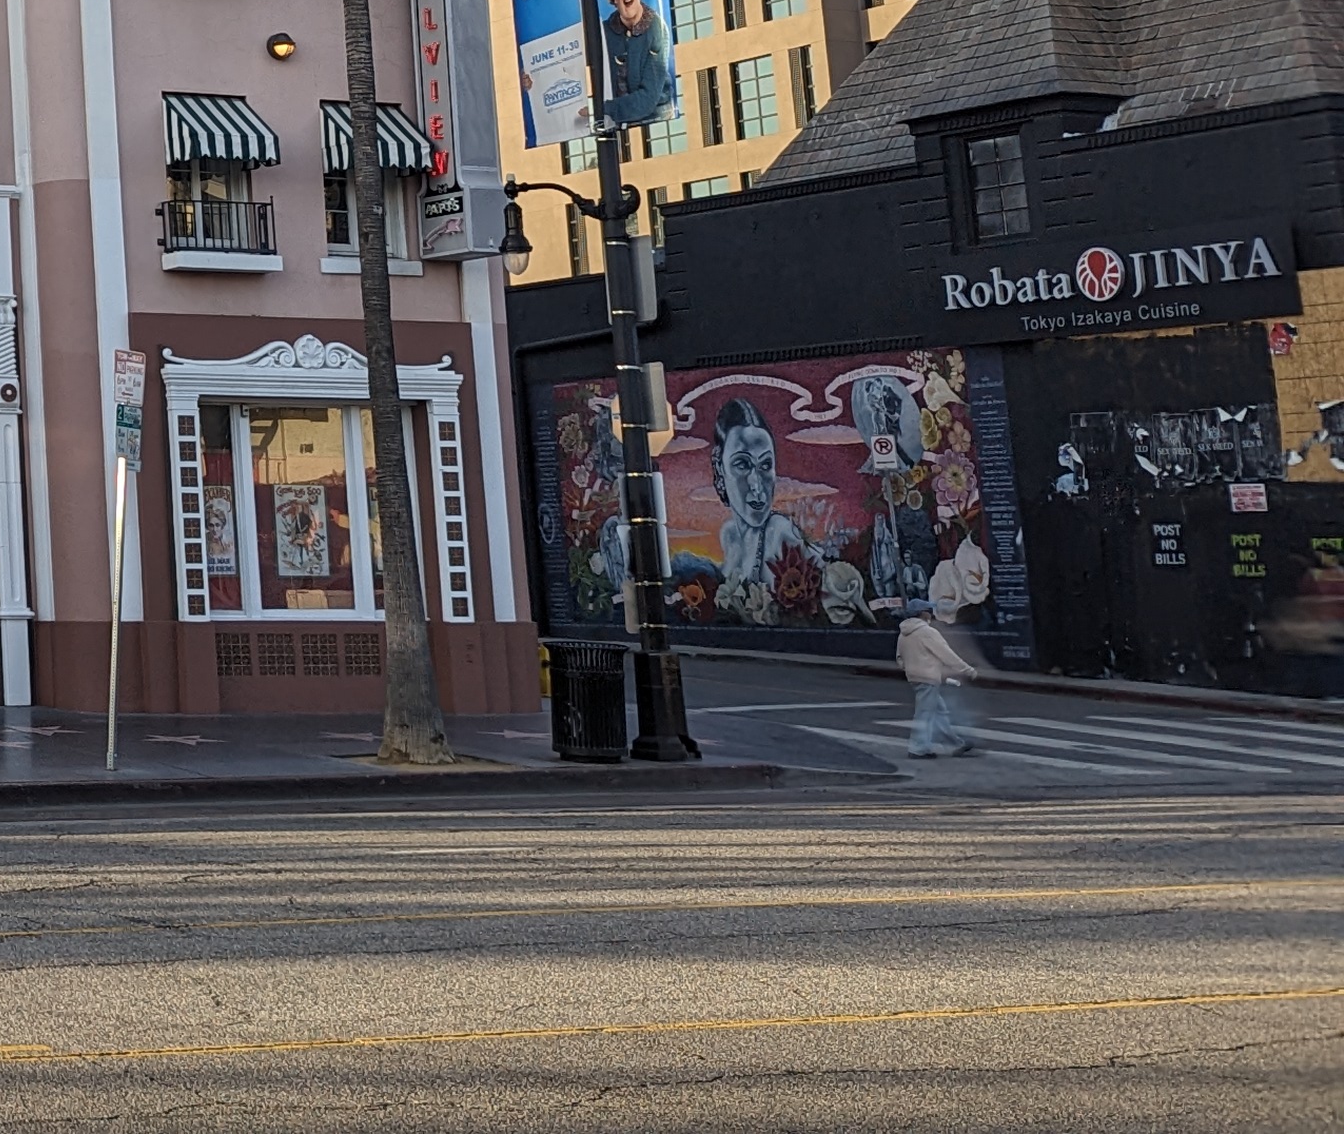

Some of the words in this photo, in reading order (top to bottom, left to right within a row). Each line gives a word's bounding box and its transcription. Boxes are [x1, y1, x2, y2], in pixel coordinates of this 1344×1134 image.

[530, 49, 554, 65] JUNE
[556, 40, 580, 56] 11-30
[941, 267, 1076, 311] Robata
[1128, 237, 1283, 298] JINYA
[1020, 315, 1065, 332] Tokyo
[1071, 310, 1132, 327] Izakaya
[1138, 302, 1201, 320] Cuisine
[1153, 524, 1181, 536] POST
[1161, 539, 1177, 550] NO
[1230, 534, 1262, 547] POST
[1155, 553, 1186, 565] BILLS
[1239, 549, 1257, 562] NO
[1233, 564, 1266, 577] BILLS
